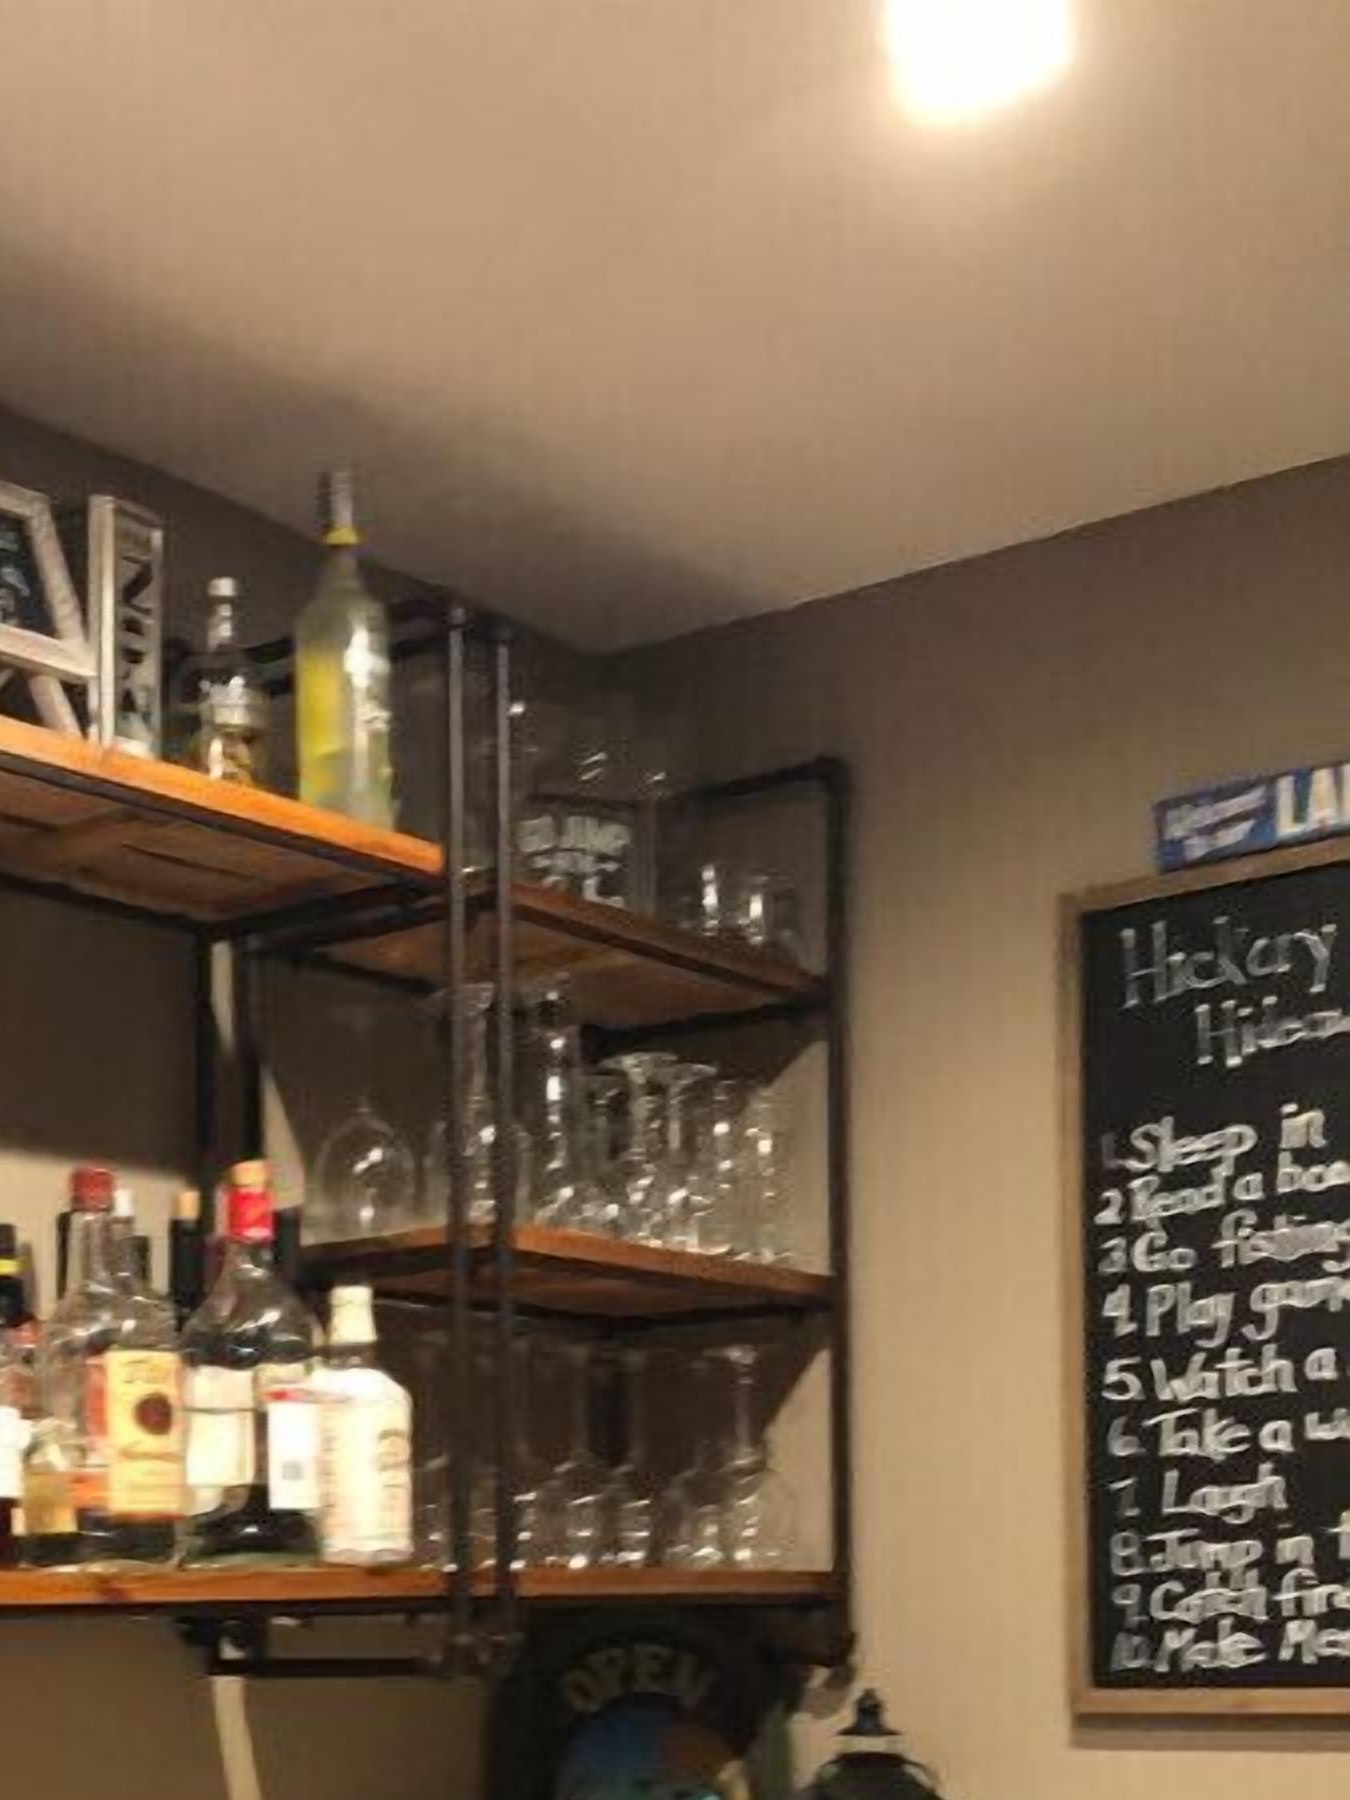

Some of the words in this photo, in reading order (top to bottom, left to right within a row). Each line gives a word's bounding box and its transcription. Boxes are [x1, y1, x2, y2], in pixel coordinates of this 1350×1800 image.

[1130, 1115, 1258, 1177] Sleep
[1232, 1171, 1266, 1201] a
[1131, 1228, 1198, 1273] Go
[1146, 1280, 1236, 1348] Play
[1102, 1356, 1145, 1401] 5
[1151, 1342, 1298, 1403] Watch
[1304, 1347, 1339, 1381] a
[1142, 1408, 1251, 1463] Take
[1258, 1419, 1295, 1453] a
